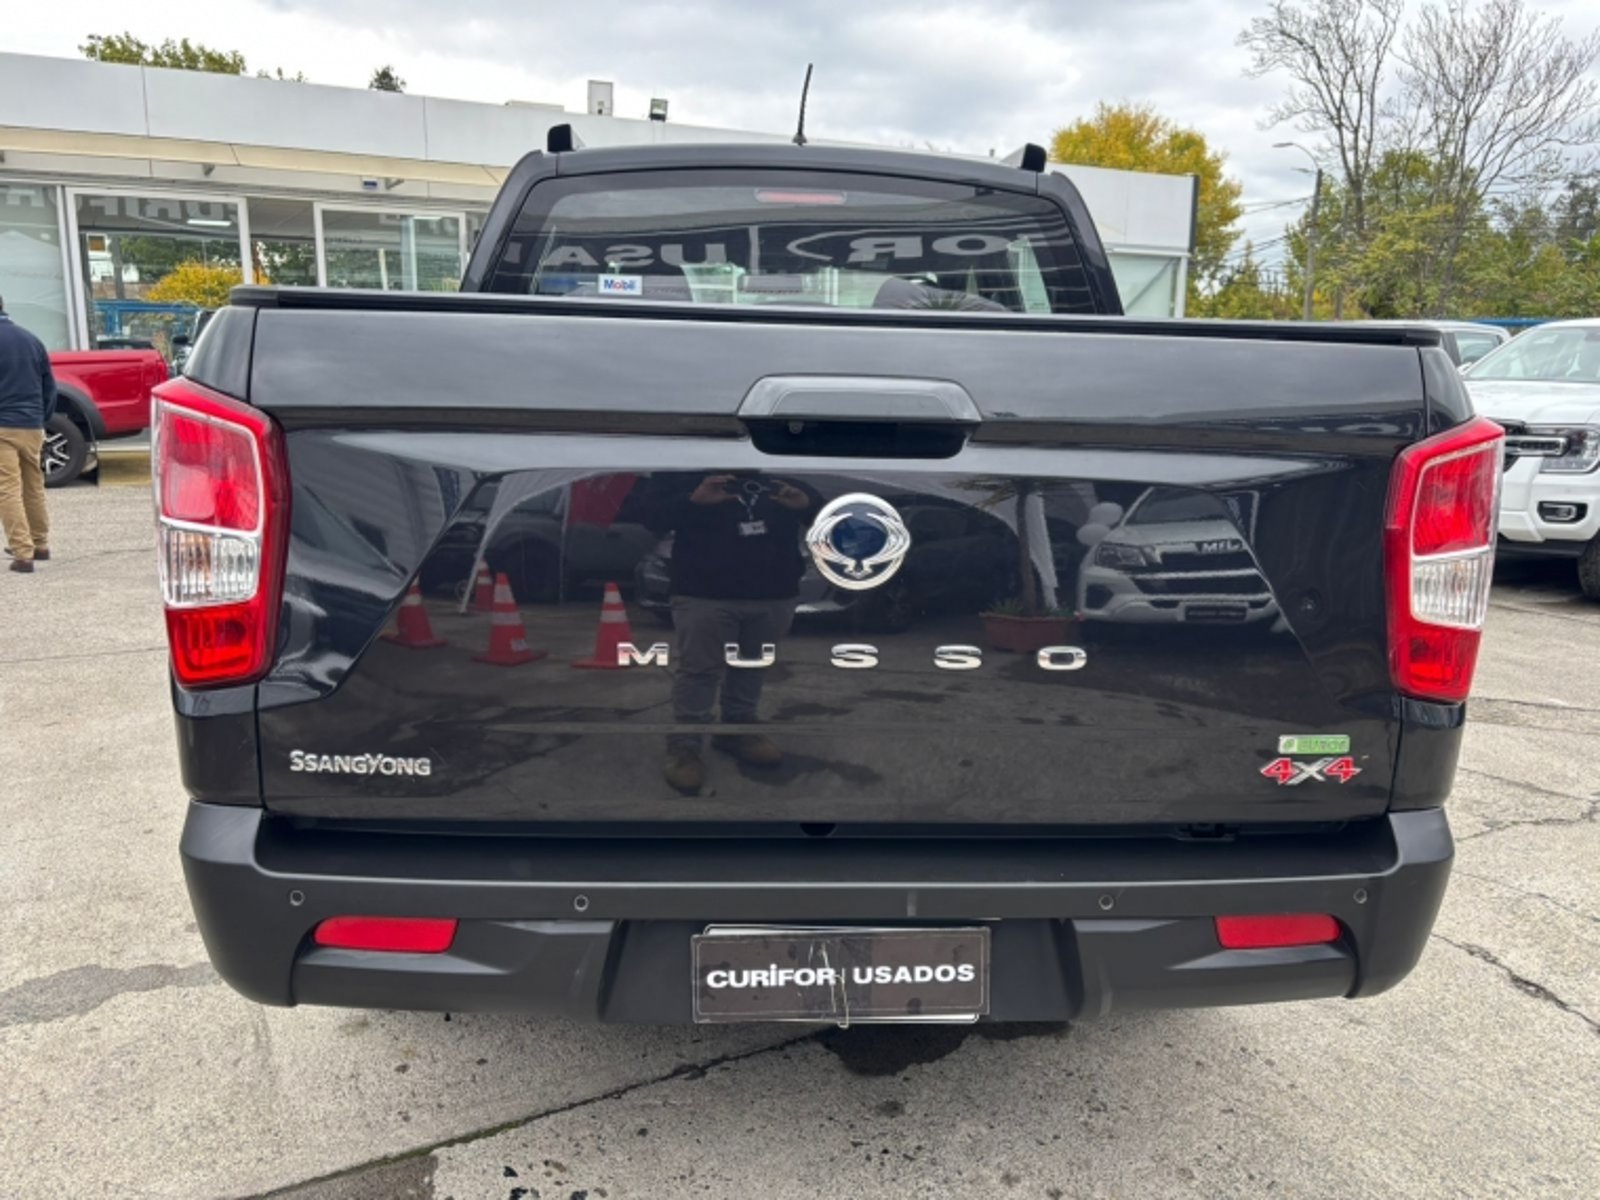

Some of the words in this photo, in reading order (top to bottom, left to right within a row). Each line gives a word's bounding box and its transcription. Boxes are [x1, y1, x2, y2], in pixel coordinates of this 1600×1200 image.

[604, 279, 637, 290] Mobil
[616, 642, 1088, 671] MUSSO
[853, 963, 976, 985] USADOS
